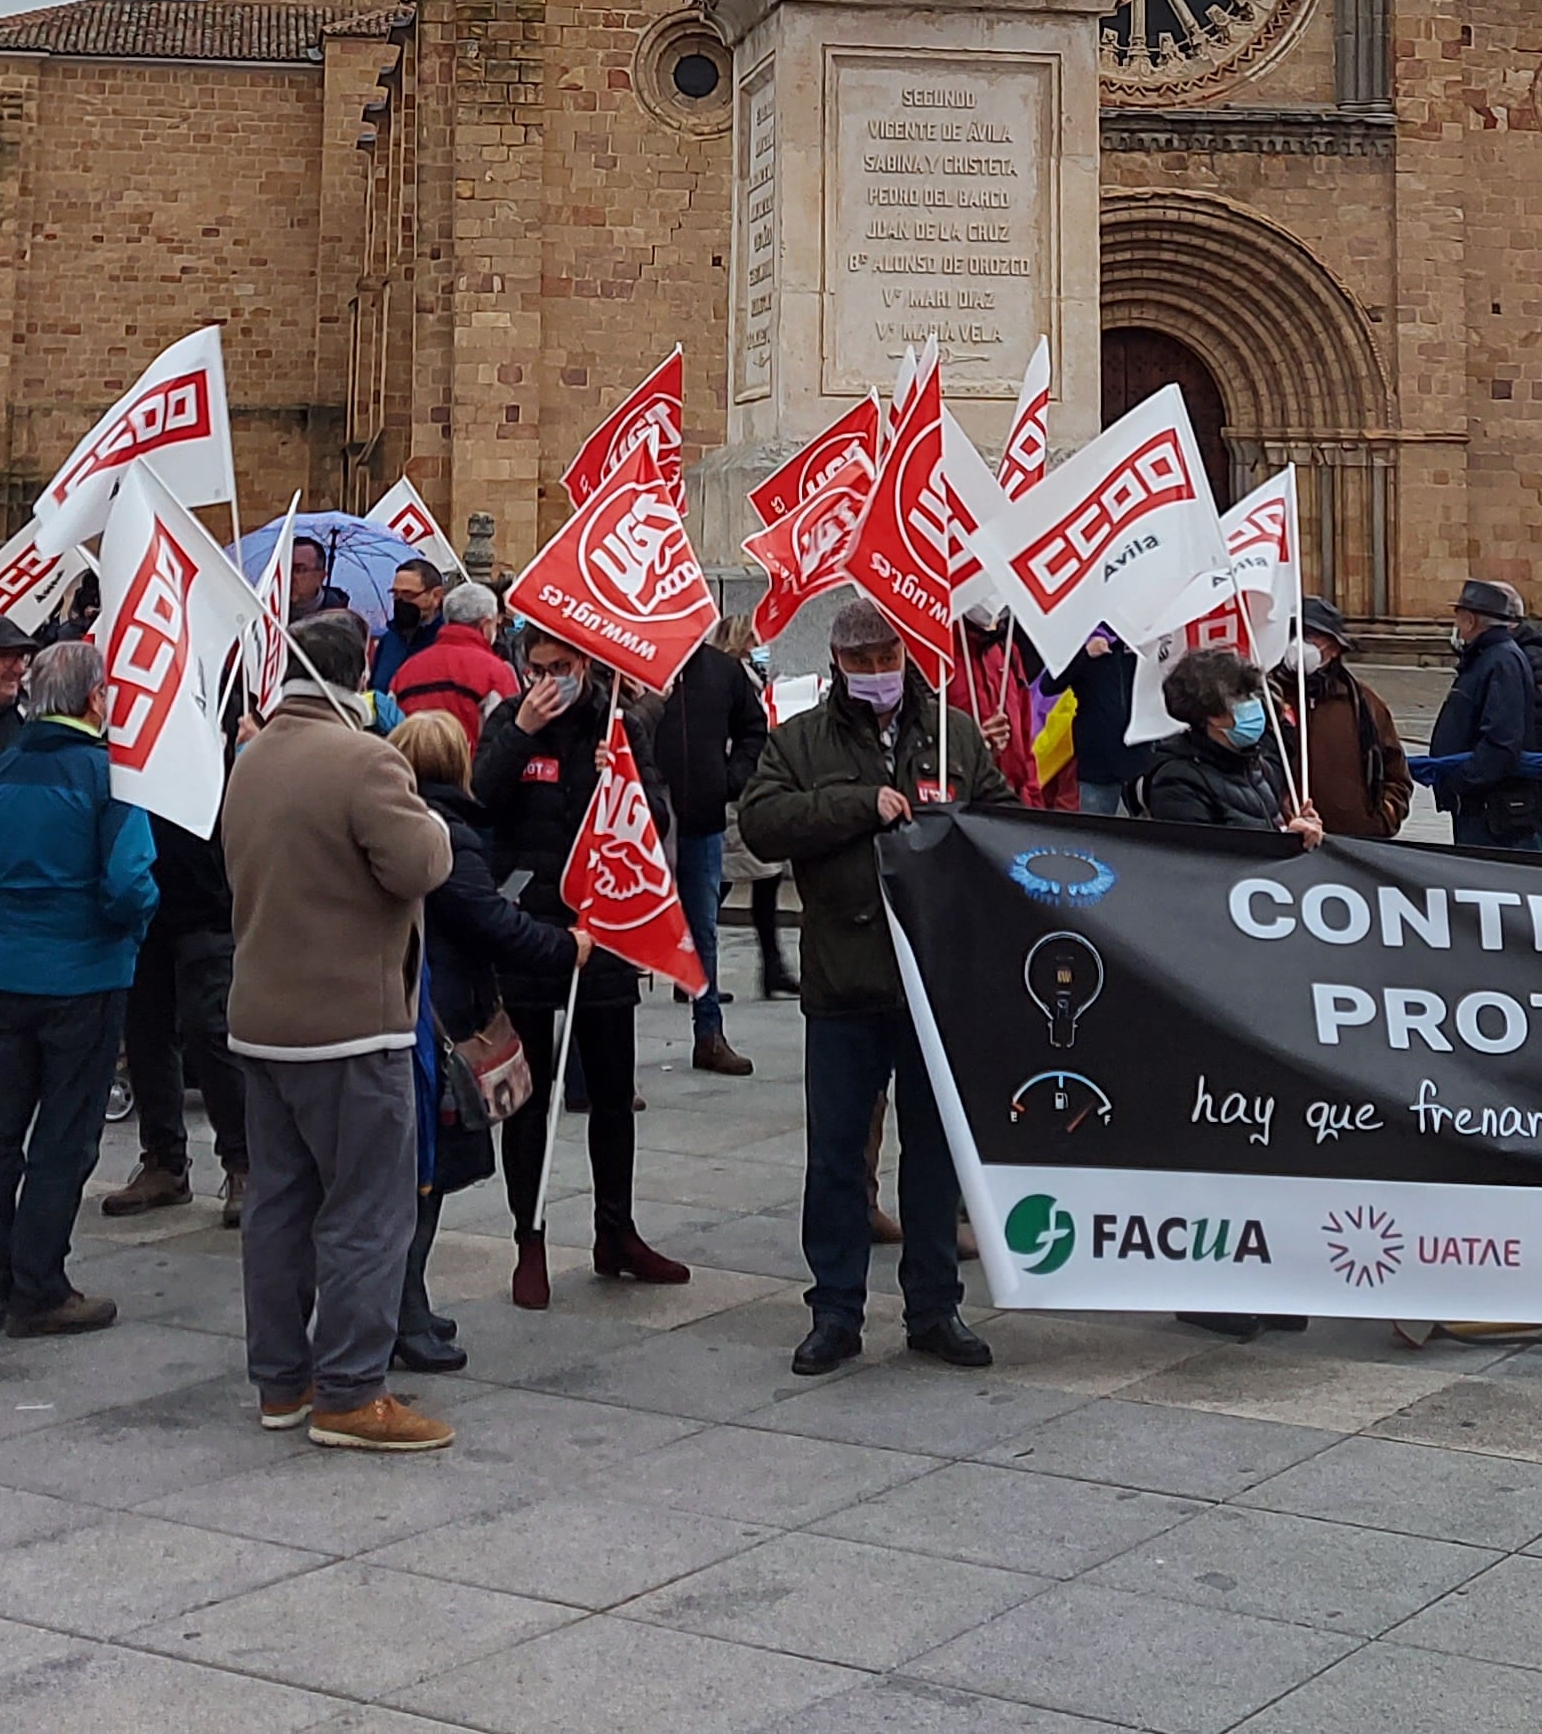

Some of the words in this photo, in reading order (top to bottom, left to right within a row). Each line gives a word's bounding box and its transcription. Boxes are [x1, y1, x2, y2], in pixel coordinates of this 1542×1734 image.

[902, 88, 977, 109] SEGUNDO
[868, 119, 938, 141] VICENTE
[941, 121, 963, 142] DE
[863, 153, 924, 175] SABINA
[925, 154, 940, 175] Y
[942, 155, 1019, 177] CRISTETA
[868, 186, 920, 207] PEDRO
[923, 188, 954, 208] DEL
[958, 187, 1011, 209] BARCO
[866, 219, 910, 241] JUAN
[914, 220, 936, 241] DE
[938, 221, 962, 242] LA
[966, 221, 1011, 243] CRUZ
[872, 254, 937, 275] ALONSO
[942, 255, 963, 275] DE
[968, 256, 1032, 278] OROZCO
[958, 322, 1004, 344] VELA
[1026, 439, 1187, 597] CCOO
[588, 492, 683, 597] UGT
[538, 583, 658, 661] www.ugt.es
[522, 762, 543, 777] GT
[1192, 1076, 1274, 1146] hay
[1306, 1100, 1384, 1145] que
[1091, 1211, 1272, 1266] FACUA
